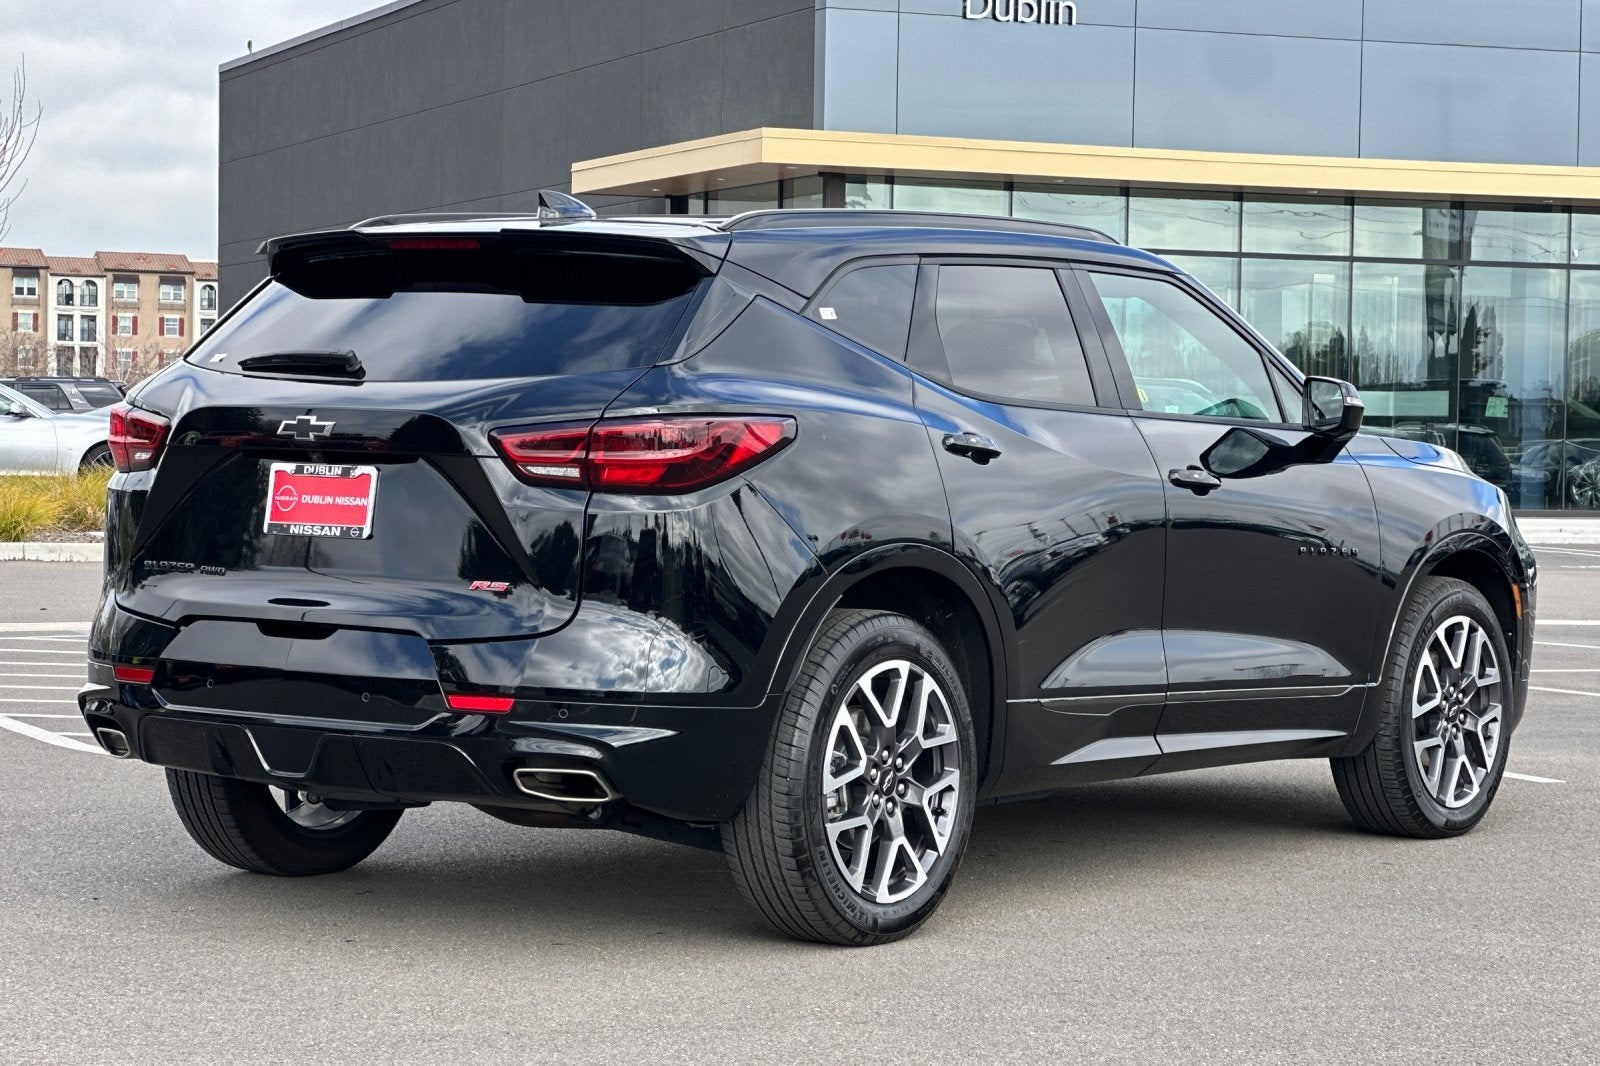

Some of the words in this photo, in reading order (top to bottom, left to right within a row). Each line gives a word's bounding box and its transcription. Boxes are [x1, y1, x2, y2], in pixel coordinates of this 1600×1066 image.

[965, 0, 1077, 25] Dublin
[303, 466, 342, 476] DUBLIN
[301, 495, 333, 504] DUBLIN
[335, 496, 369, 506] NISSAN
[289, 525, 340, 536] NISSAN
[468, 581, 510, 592] RS
[818, 849, 858, 914] MICHELIN
